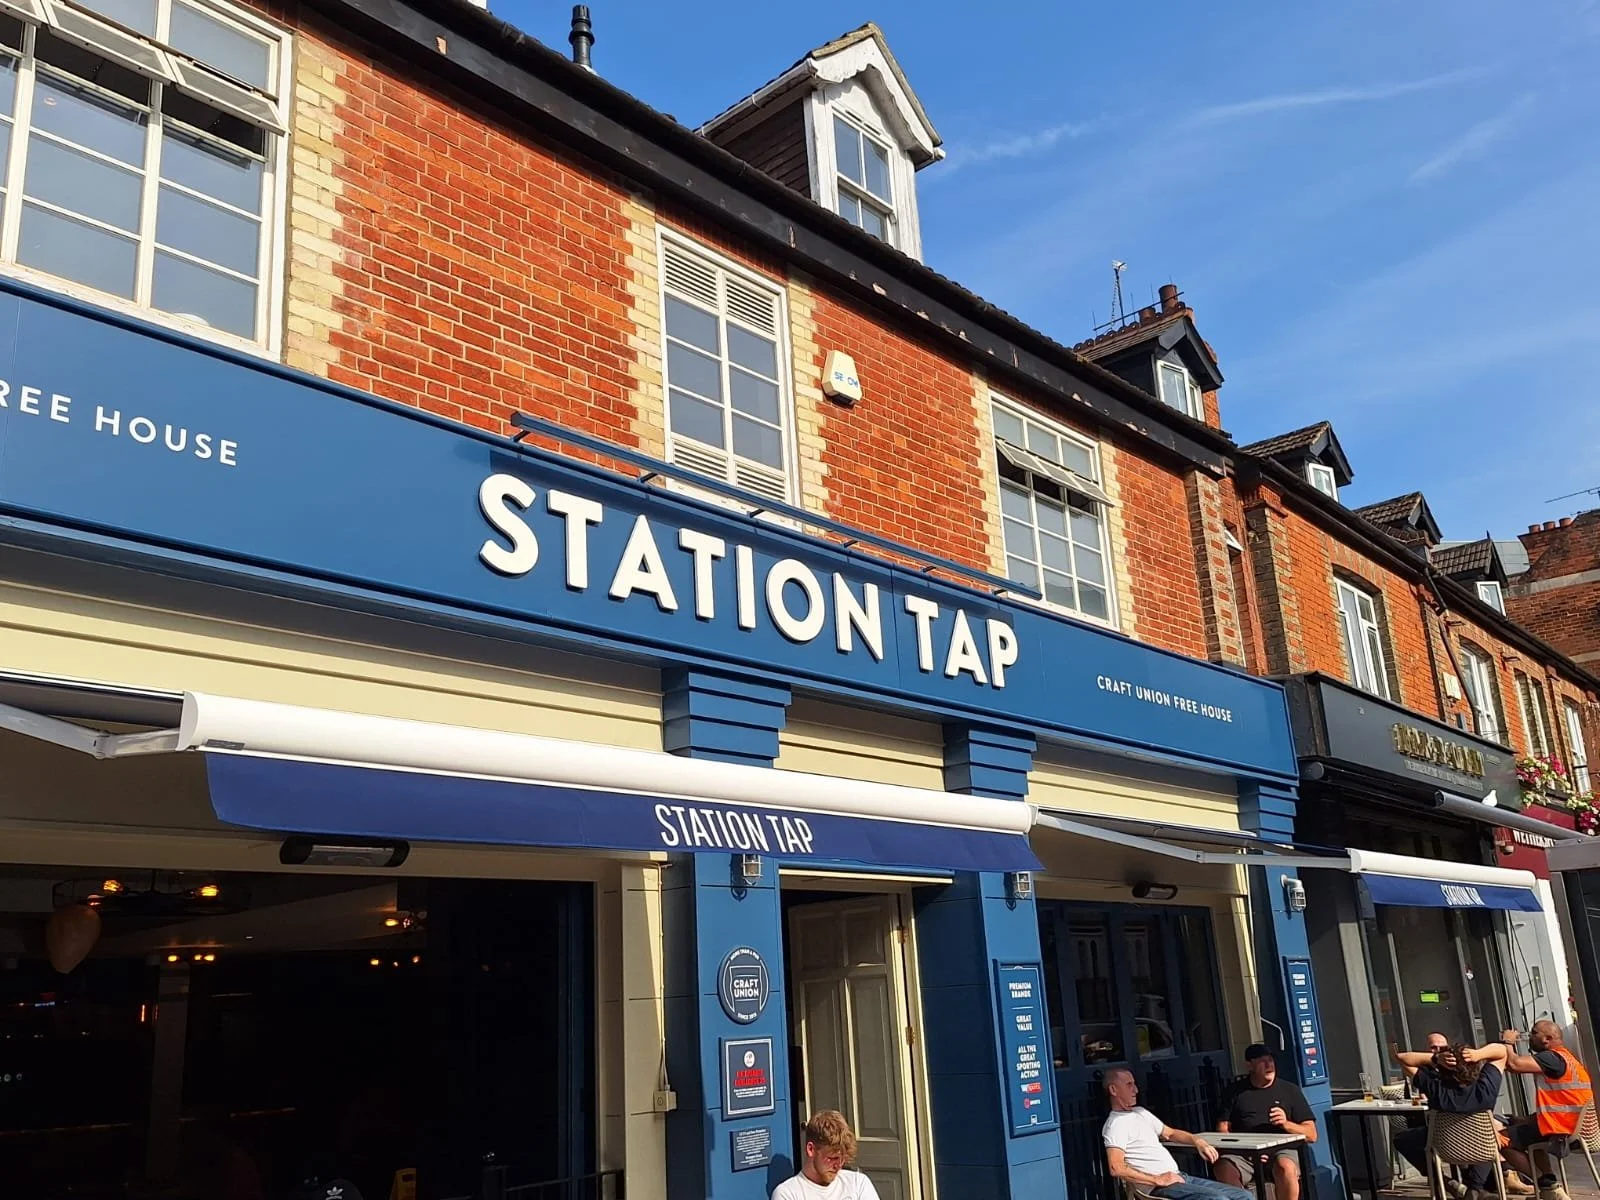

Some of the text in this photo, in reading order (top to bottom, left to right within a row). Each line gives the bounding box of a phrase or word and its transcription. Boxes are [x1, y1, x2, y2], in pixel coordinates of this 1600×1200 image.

[95, 405, 238, 466] HOUSE
[479, 473, 1019, 688] STATION TAP
[1097, 675, 1233, 723] CRAFT UNION FREE HOUSE
[655, 803, 814, 854] STATION TAP
[733, 978, 759, 988] CRAFT
[733, 988, 760, 998] UNION
[1015, 1014, 1032, 1023] GREAT
[1016, 1022, 1033, 1031] VALUE
[1017, 1044, 1037, 1054] ALL THE
[1020, 1053, 1036, 1062] GREAT
[1016, 1061, 1041, 1072] SPORTING
[1020, 1070, 1040, 1080] ACTION
